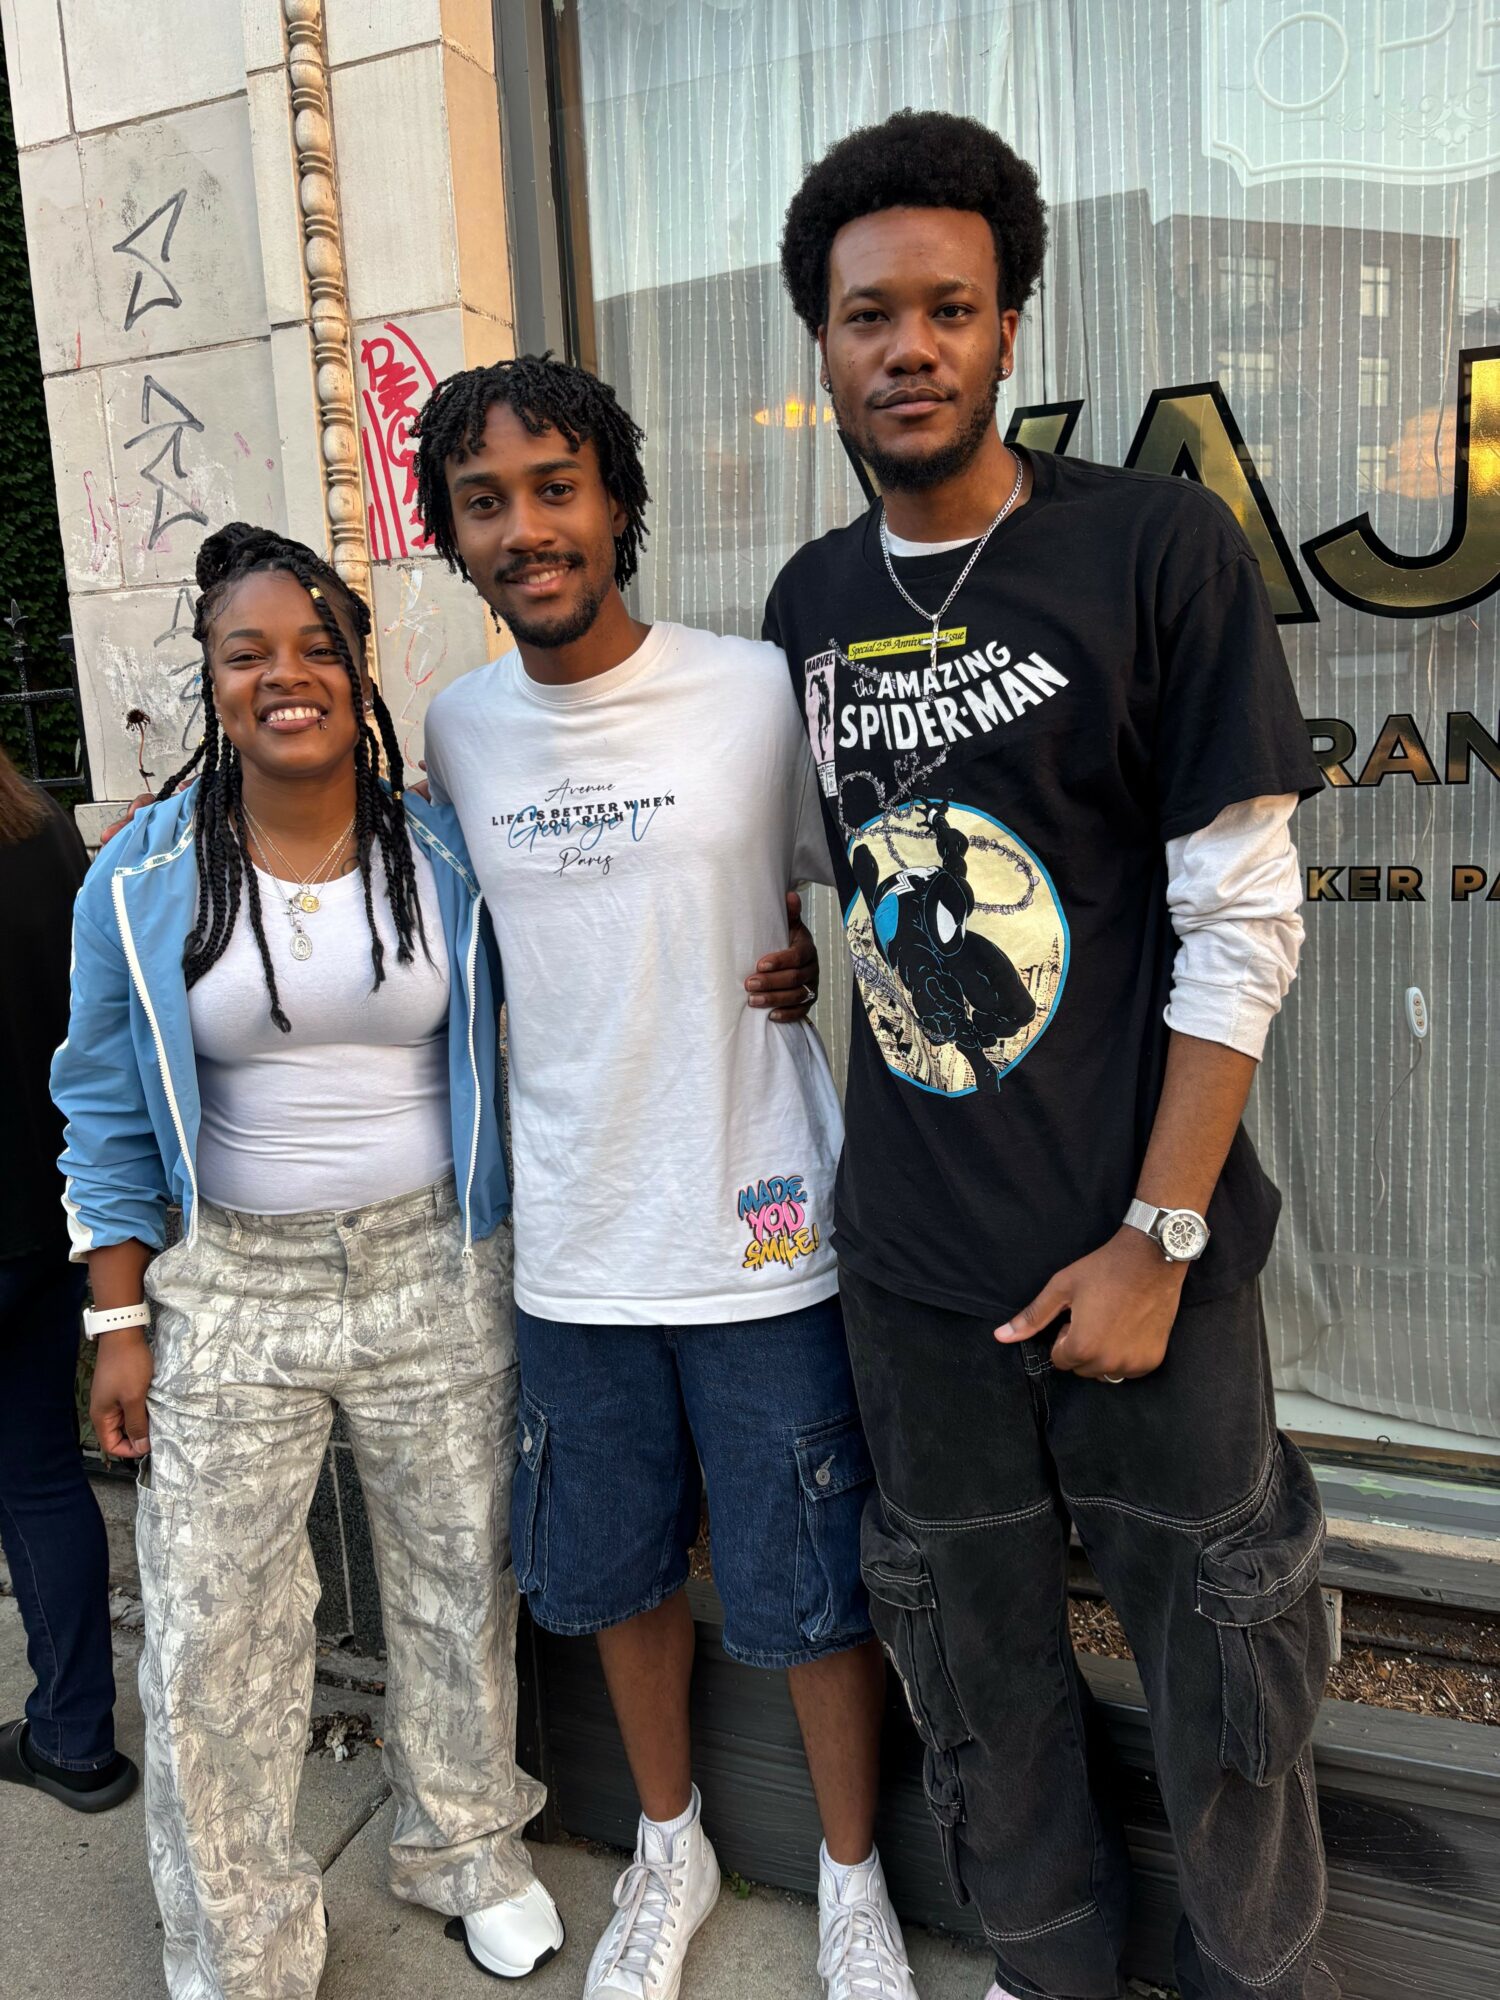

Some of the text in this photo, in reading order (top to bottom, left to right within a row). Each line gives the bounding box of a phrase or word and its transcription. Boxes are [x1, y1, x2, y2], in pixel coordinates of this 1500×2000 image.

[805, 652, 834, 674] MARVEL
[849, 640, 875, 657] Special
[852, 640, 1011, 699] the AMAZING
[544, 778, 616, 804] Avenue
[492, 795, 676, 826] LIFE IS BETTER WHEN
[536, 811, 625, 831] YOU RICH
[508, 805, 624, 853] George
[553, 846, 615, 878] Paris
[1301, 865, 1426, 902] KER
[737, 1175, 808, 1221] MADE
[746, 1200, 806, 1248] YOU
